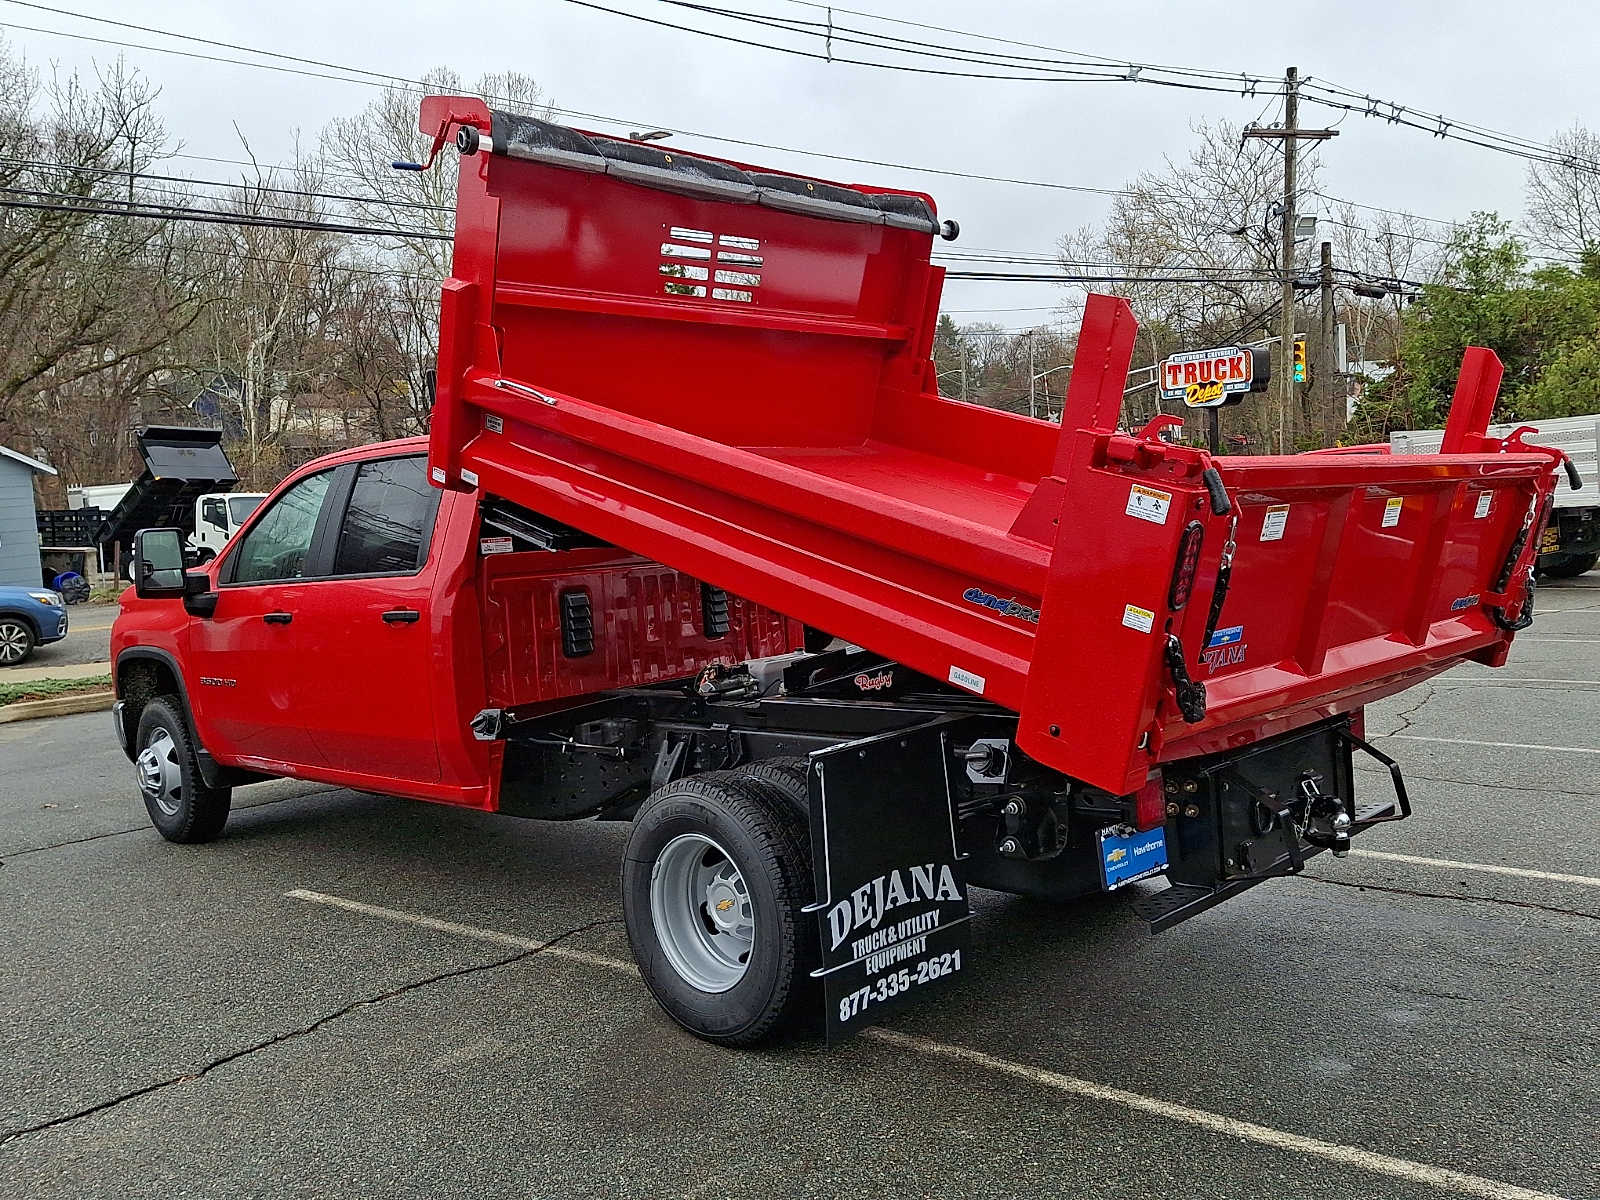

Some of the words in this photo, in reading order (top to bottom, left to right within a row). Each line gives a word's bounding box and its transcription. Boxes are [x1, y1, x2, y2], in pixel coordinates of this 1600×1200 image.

[1167, 357, 1244, 386] TRUCK
[1186, 382, 1224, 403] Depot
[854, 671, 893, 691] Rugby
[953, 672, 980, 687] GASOLINE
[1134, 840, 1163, 856] Hawthorne
[827, 863, 963, 952] DEJANA
[865, 936, 927, 976] EQUIPMENT
[839, 949, 962, 1022] 877-335-2621
